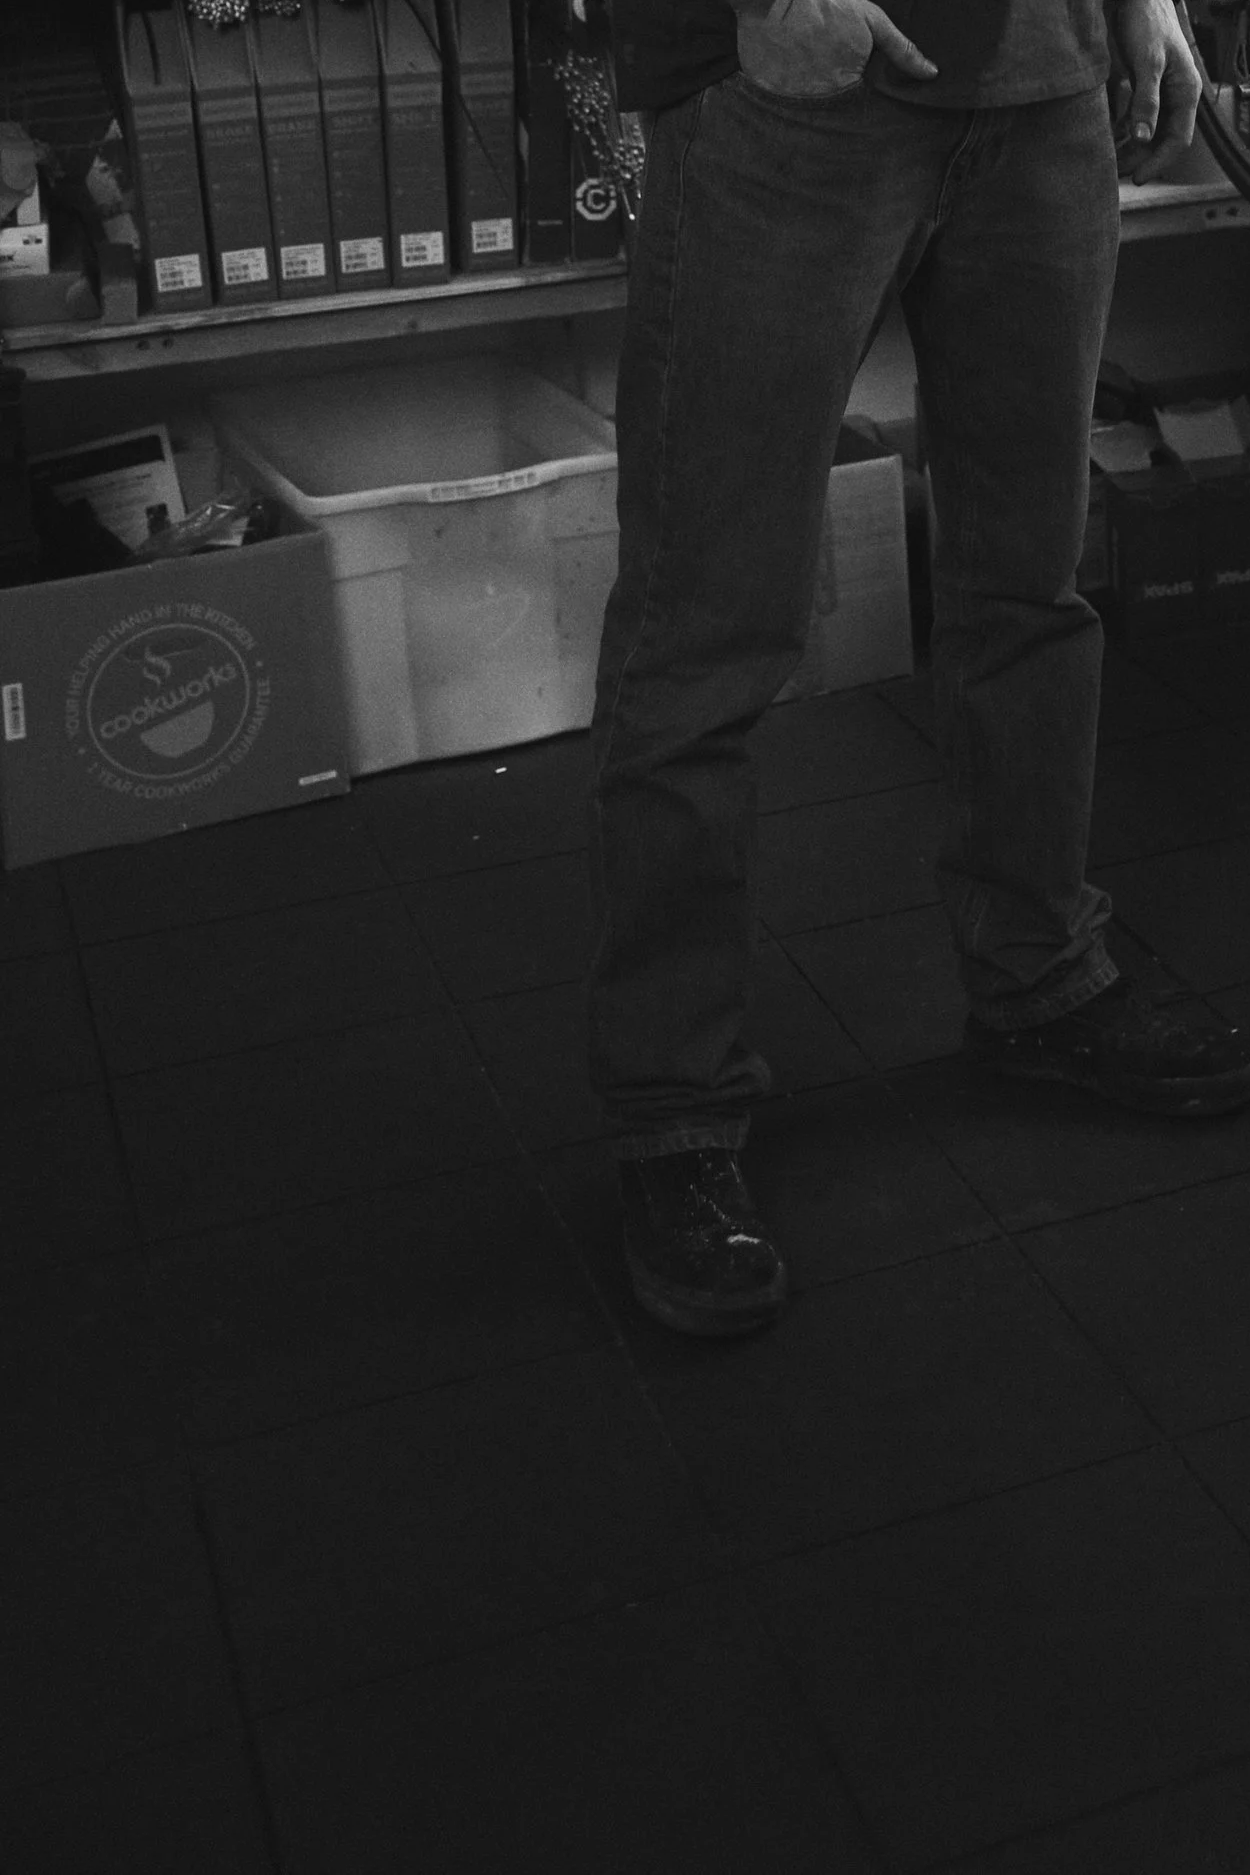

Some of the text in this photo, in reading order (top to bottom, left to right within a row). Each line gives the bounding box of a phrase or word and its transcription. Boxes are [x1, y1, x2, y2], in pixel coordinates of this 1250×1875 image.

[107, 609, 153, 639] HAND
[153, 604, 171, 619] IN
[175, 602, 205, 620] THE
[204, 606, 257, 652] KITCHEN
[69, 634, 111, 696] HELPING
[65, 697, 81, 740] YOUR
[99, 663, 238, 740] cookworks
[97, 769, 133, 794] YEAR
[133, 762, 231, 800] COOKWORKS
[227, 675, 271, 764] GUARANTEE
